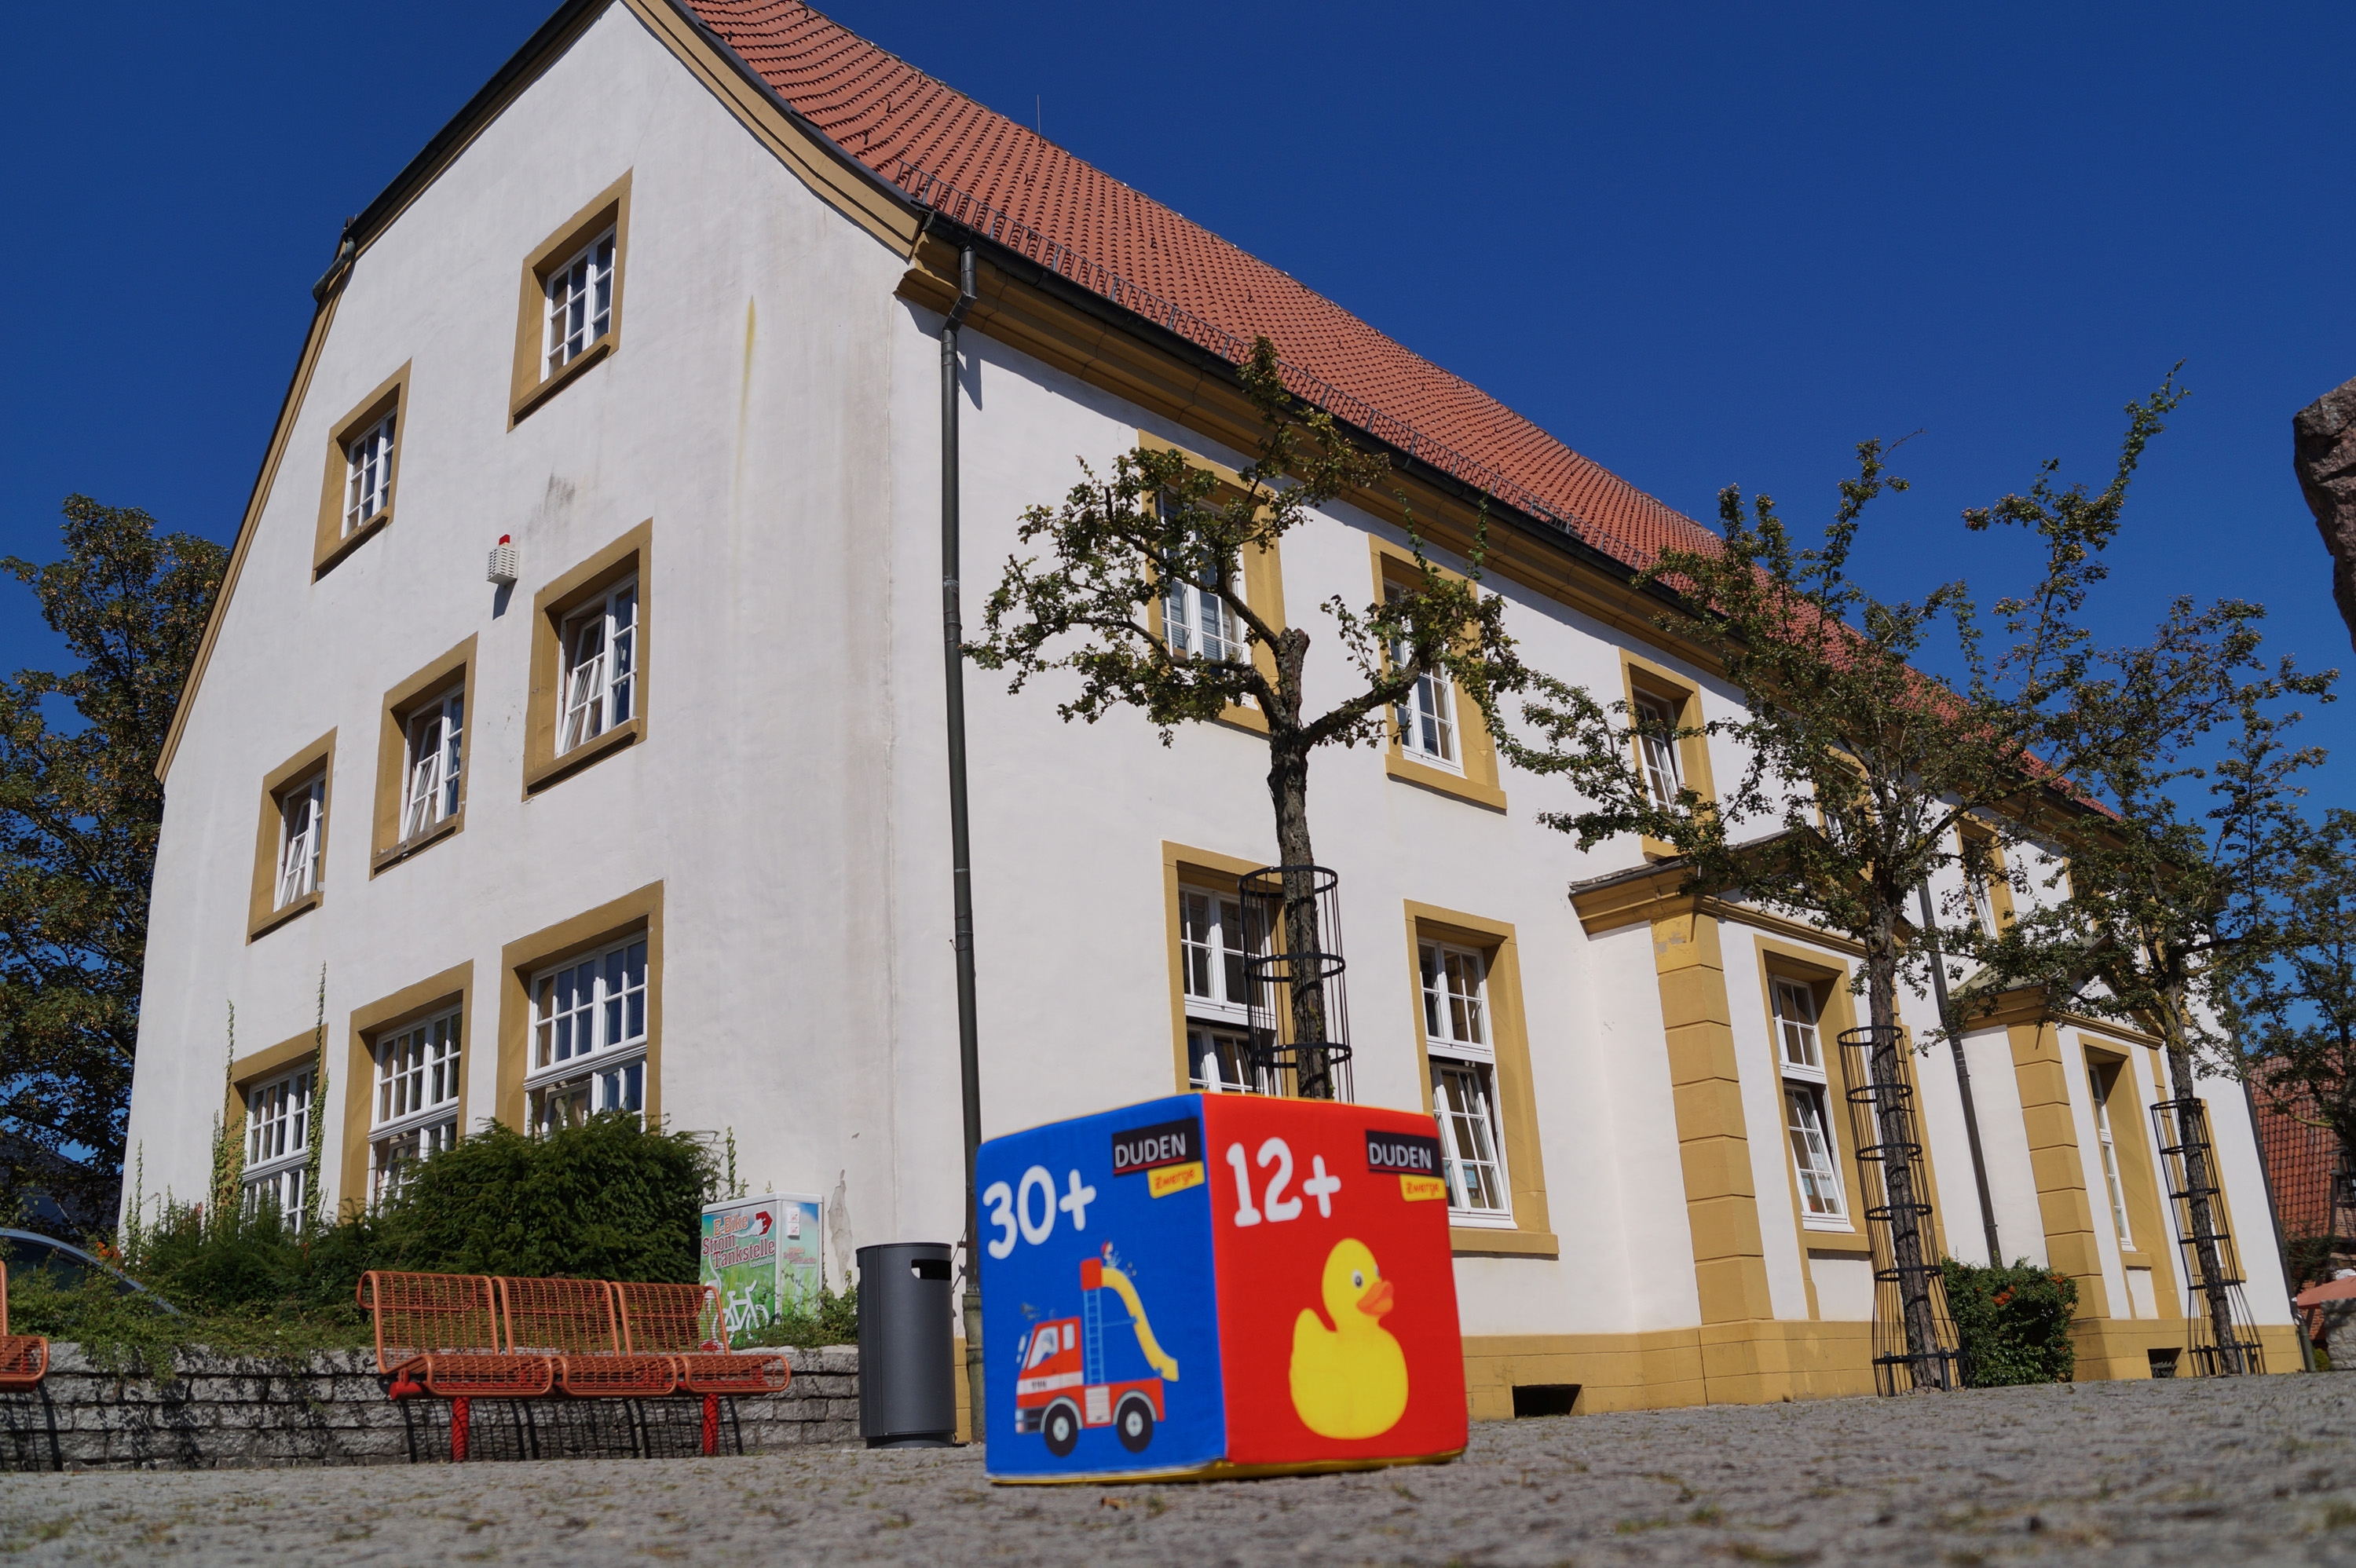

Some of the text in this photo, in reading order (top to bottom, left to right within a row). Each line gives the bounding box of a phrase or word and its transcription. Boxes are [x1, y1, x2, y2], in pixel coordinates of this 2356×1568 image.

[1115, 1132, 1186, 1168] DUDEN
[1369, 1142, 1432, 1169] DUDEN
[1226, 1137, 1342, 1227] 12+
[714, 1215, 748, 1237] E-Bike
[982, 1164, 1096, 1259] 30+
[703, 1235, 735, 1255] Strom
[714, 1238, 774, 1268] Tankstelle
